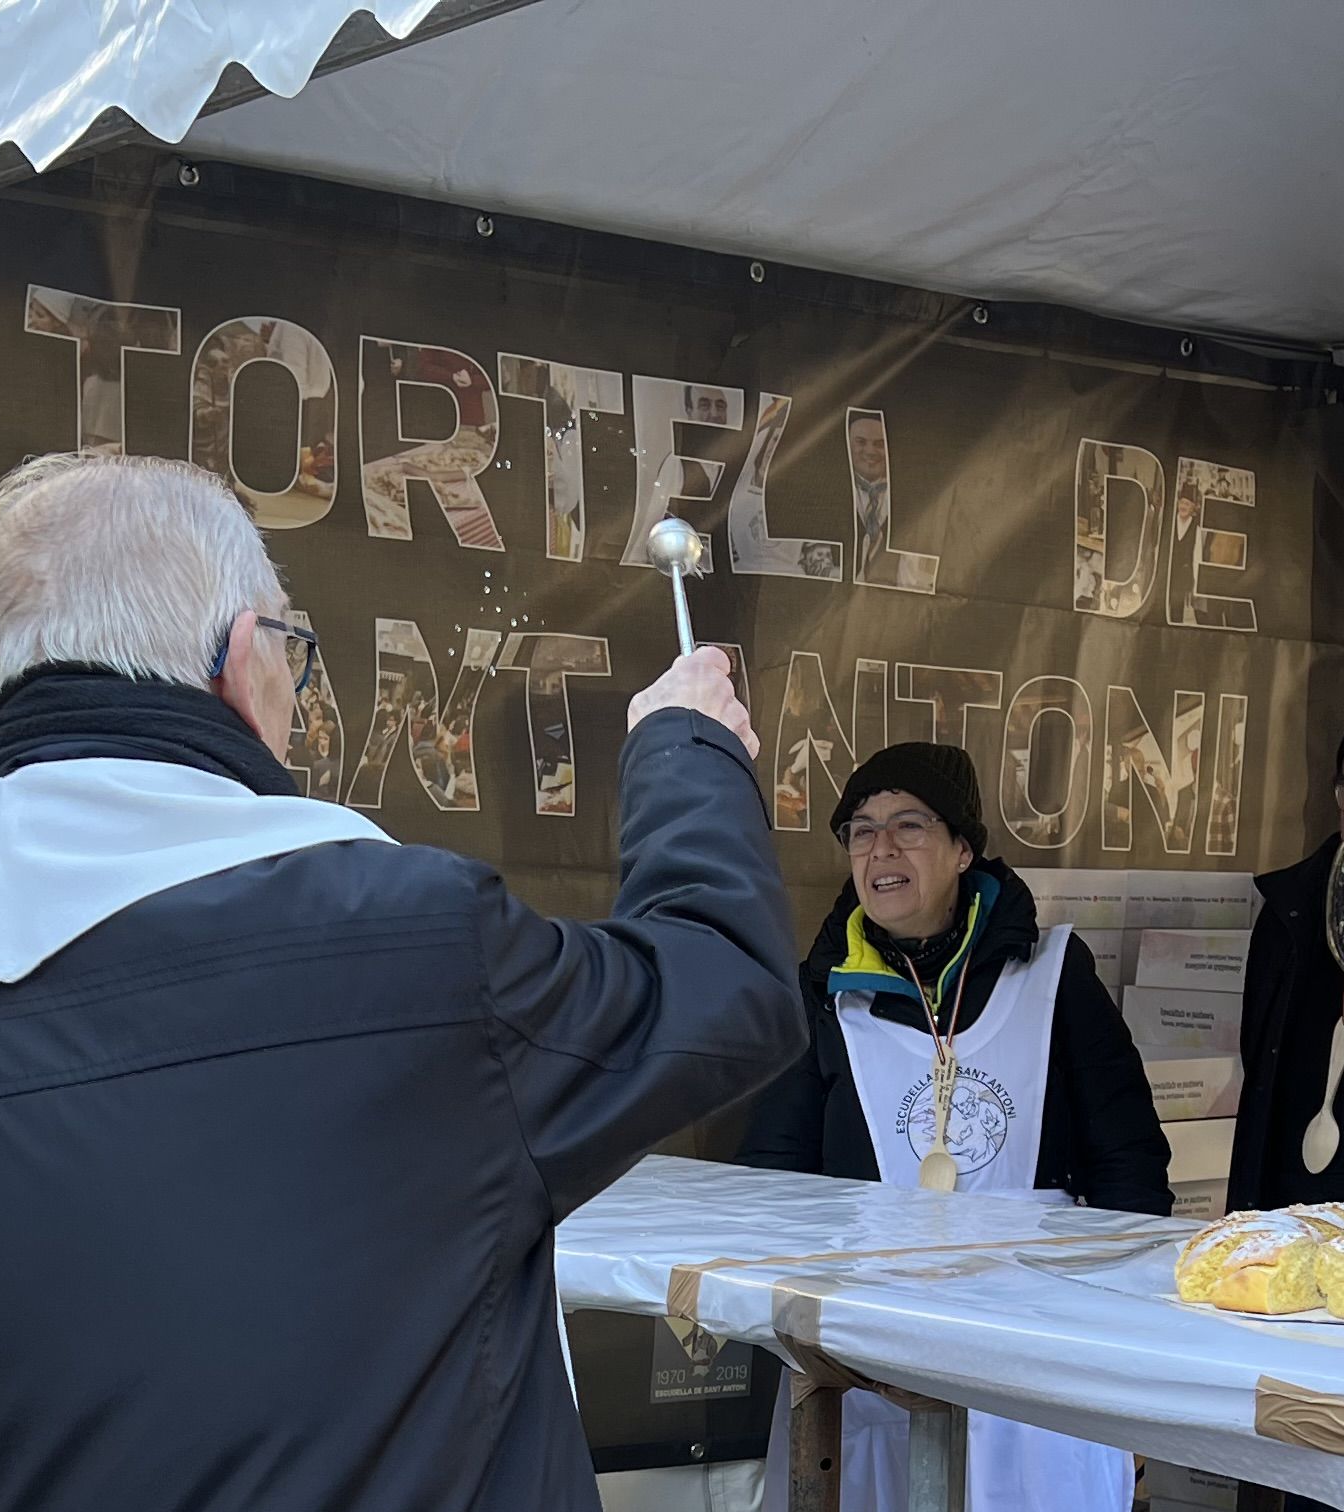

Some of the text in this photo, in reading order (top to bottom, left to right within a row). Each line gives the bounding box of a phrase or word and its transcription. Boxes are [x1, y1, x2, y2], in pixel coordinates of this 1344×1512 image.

[24, 284, 1257, 632] TORTELL DE
[284, 609, 1249, 856] ANT NTONI
[896, 1073, 933, 1134] ESCUDELLA
[955, 1066, 988, 1080] SANT
[988, 1078, 1017, 1119] ANTONI
[656, 1364, 748, 1385] 1970 2019
